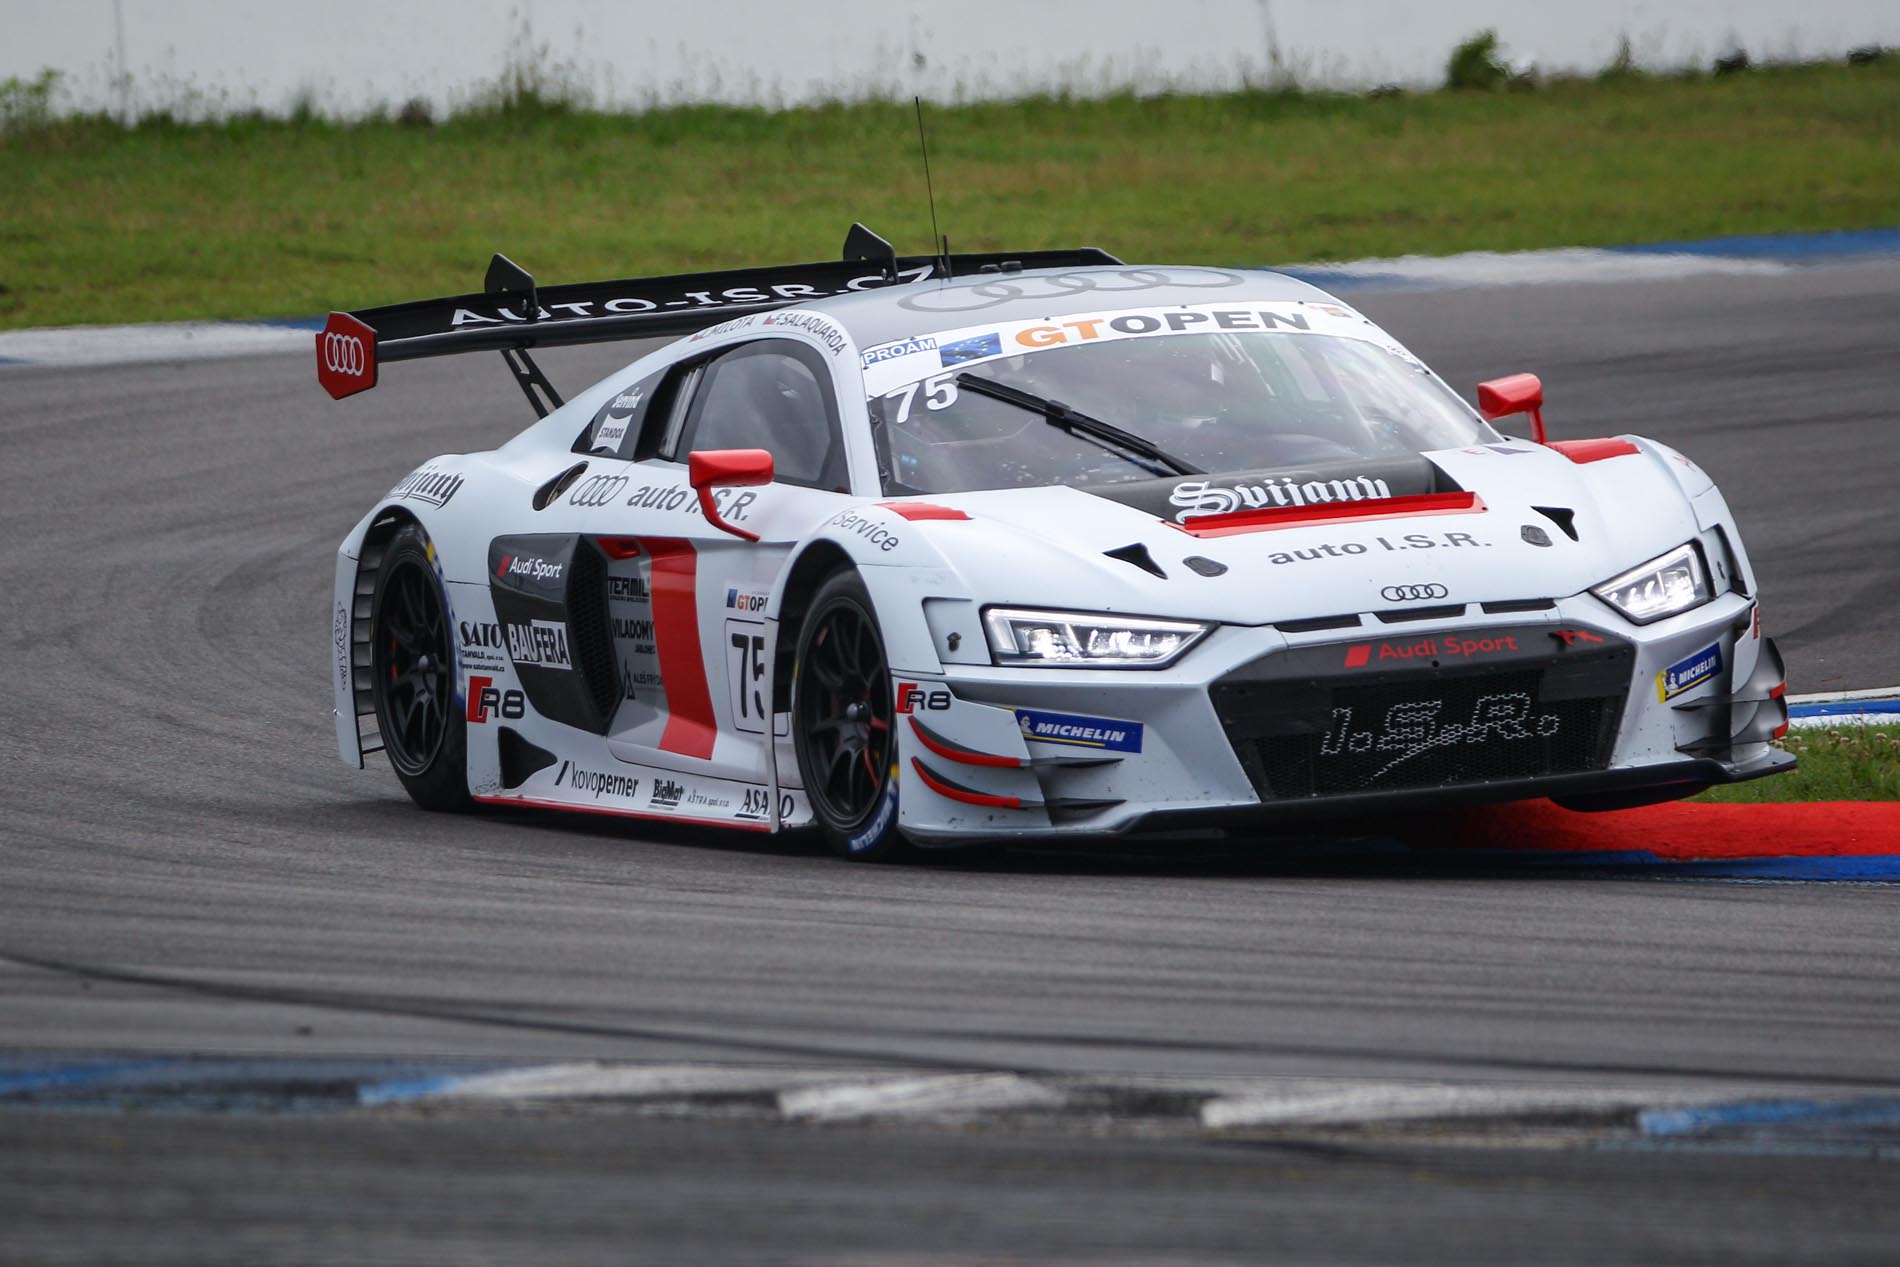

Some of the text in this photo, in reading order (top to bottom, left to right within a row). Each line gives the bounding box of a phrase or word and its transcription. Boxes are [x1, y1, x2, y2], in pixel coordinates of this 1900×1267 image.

[450, 264, 934, 326] AUTO-ISR.CZ
[1015, 311, 1310, 349] GTOPEN
[864, 339, 936, 364] PROAM
[885, 373, 958, 424] 75
[628, 484, 688, 511] auto
[832, 510, 900, 552] Service
[1269, 532, 1493, 565] auto I.S.R.
[509, 556, 563, 581] Audi Sport
[460, 621, 503, 649] SATO
[508, 623, 571, 665] BAUFERA
[1378, 635, 1518, 663] Audi Sport
[1679, 655, 1717, 685] MICHELIN
[478, 687, 526, 720] R8
[904, 689, 951, 711] R8
[1036, 721, 1126, 743] MICHELIN
[571, 761, 640, 799] kovoperner
[652, 778, 684, 801] BigMat
[740, 788, 795, 819] ASAO
